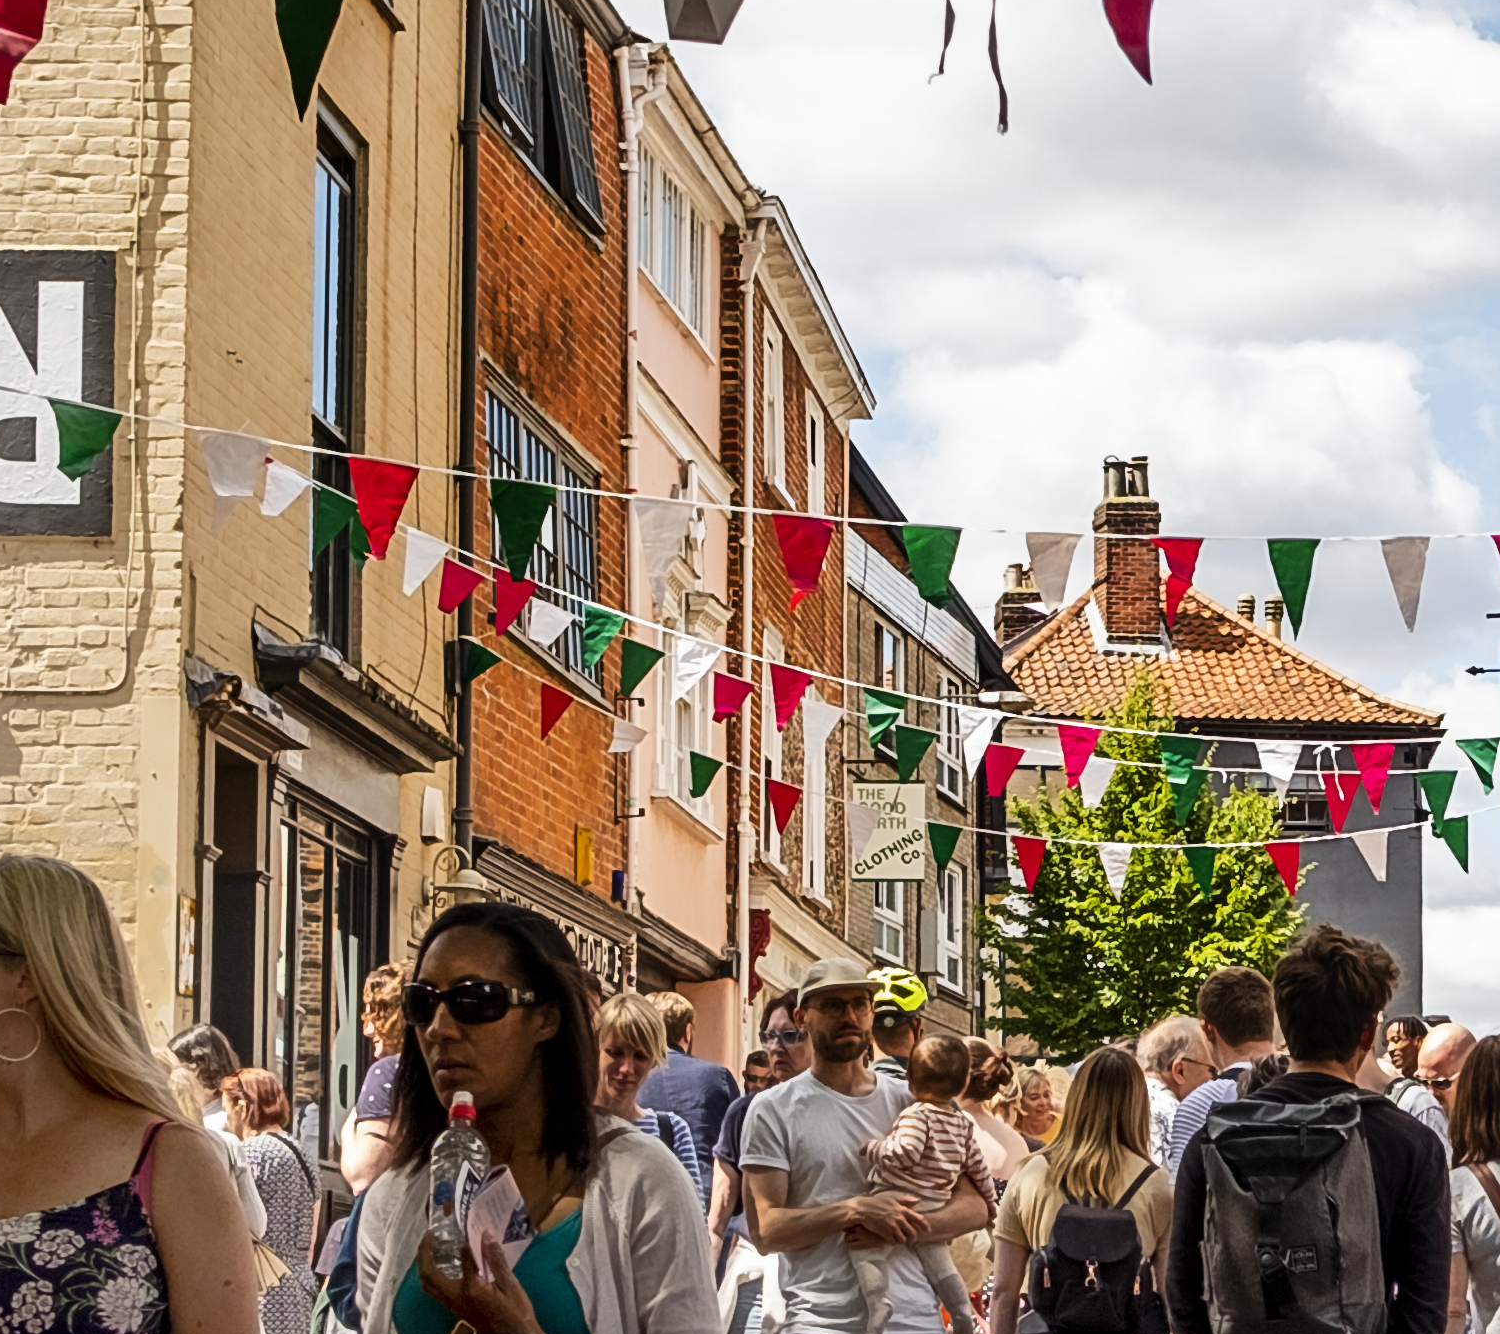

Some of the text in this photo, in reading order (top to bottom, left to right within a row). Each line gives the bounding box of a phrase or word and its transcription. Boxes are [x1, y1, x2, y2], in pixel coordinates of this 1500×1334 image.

[857, 788, 886, 800] THE
[859, 801, 906, 815] OOD
[854, 828, 924, 875] CLOTHING
